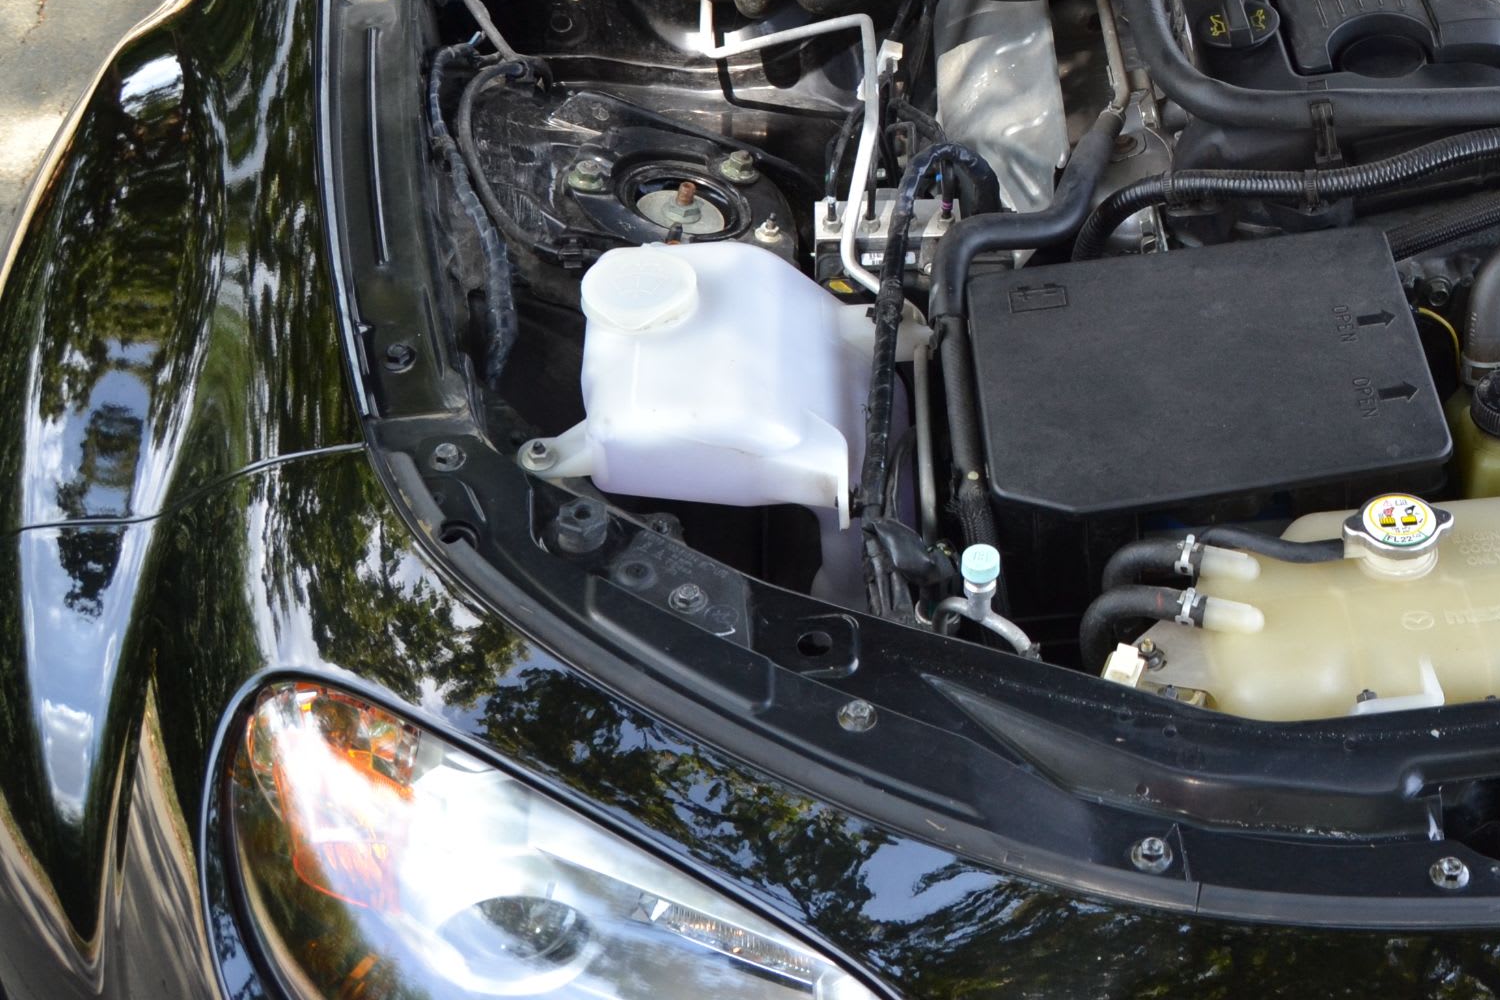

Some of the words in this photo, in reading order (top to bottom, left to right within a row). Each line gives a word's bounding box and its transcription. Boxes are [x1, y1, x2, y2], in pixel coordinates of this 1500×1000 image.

[1331, 304, 1357, 345] OPEN
[1352, 376, 1379, 420] OPEN
[1386, 534, 1413, 543] FL22
